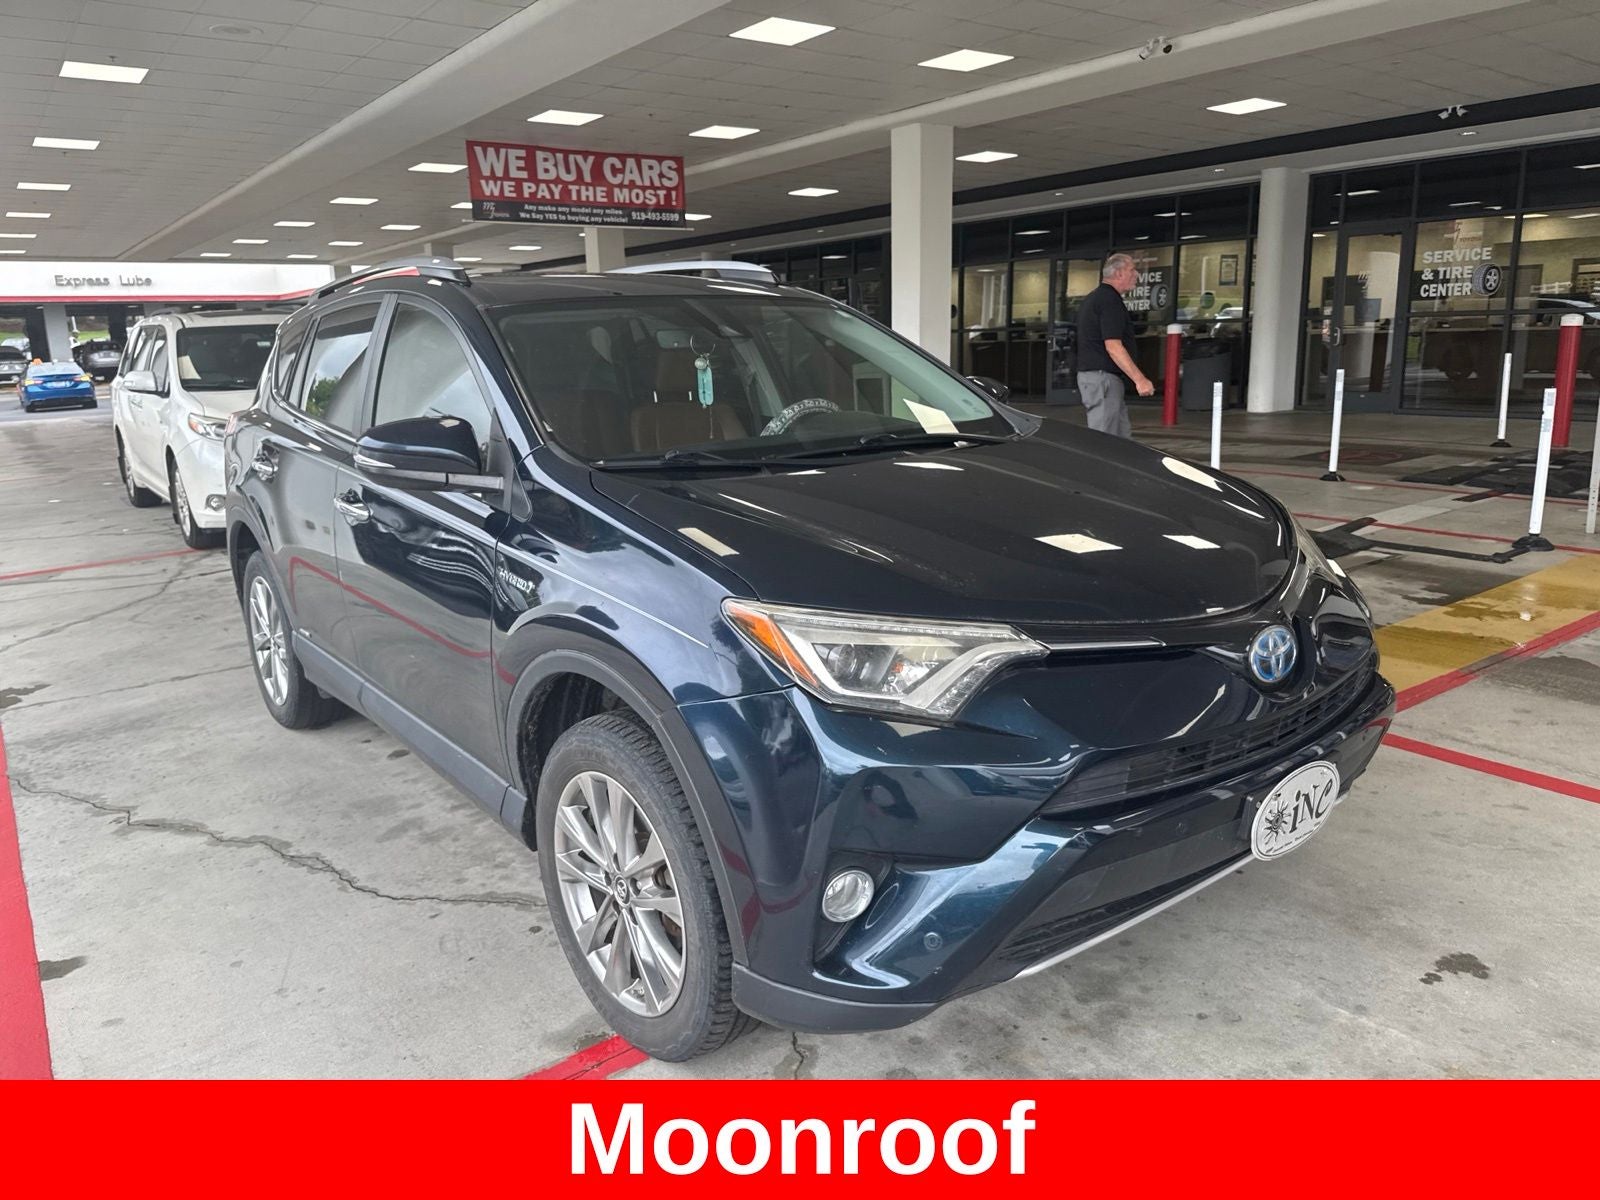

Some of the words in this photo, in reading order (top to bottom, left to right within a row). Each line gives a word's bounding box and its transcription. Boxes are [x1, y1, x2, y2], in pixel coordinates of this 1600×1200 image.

[473, 146, 528, 179] WE
[535, 150, 595, 183] BUY
[602, 156, 679, 188] CARS
[480, 179, 517, 197] WE
[522, 182, 563, 200] PAY
[568, 185, 608, 203] THE
[524, 203, 536, 212] Any
[531, 212, 544, 220] Say
[567, 214, 590, 222] buying
[1422, 247, 1493, 264] SERVICE
[1138, 271, 1162, 283] VICE
[1421, 268, 1434, 281] &
[1437, 265, 1474, 280] TIRE
[54, 274, 110, 288] Express
[119, 274, 152, 287] Lube
[1420, 282, 1473, 298] CENTER
[1123, 299, 1151, 311] NTER
